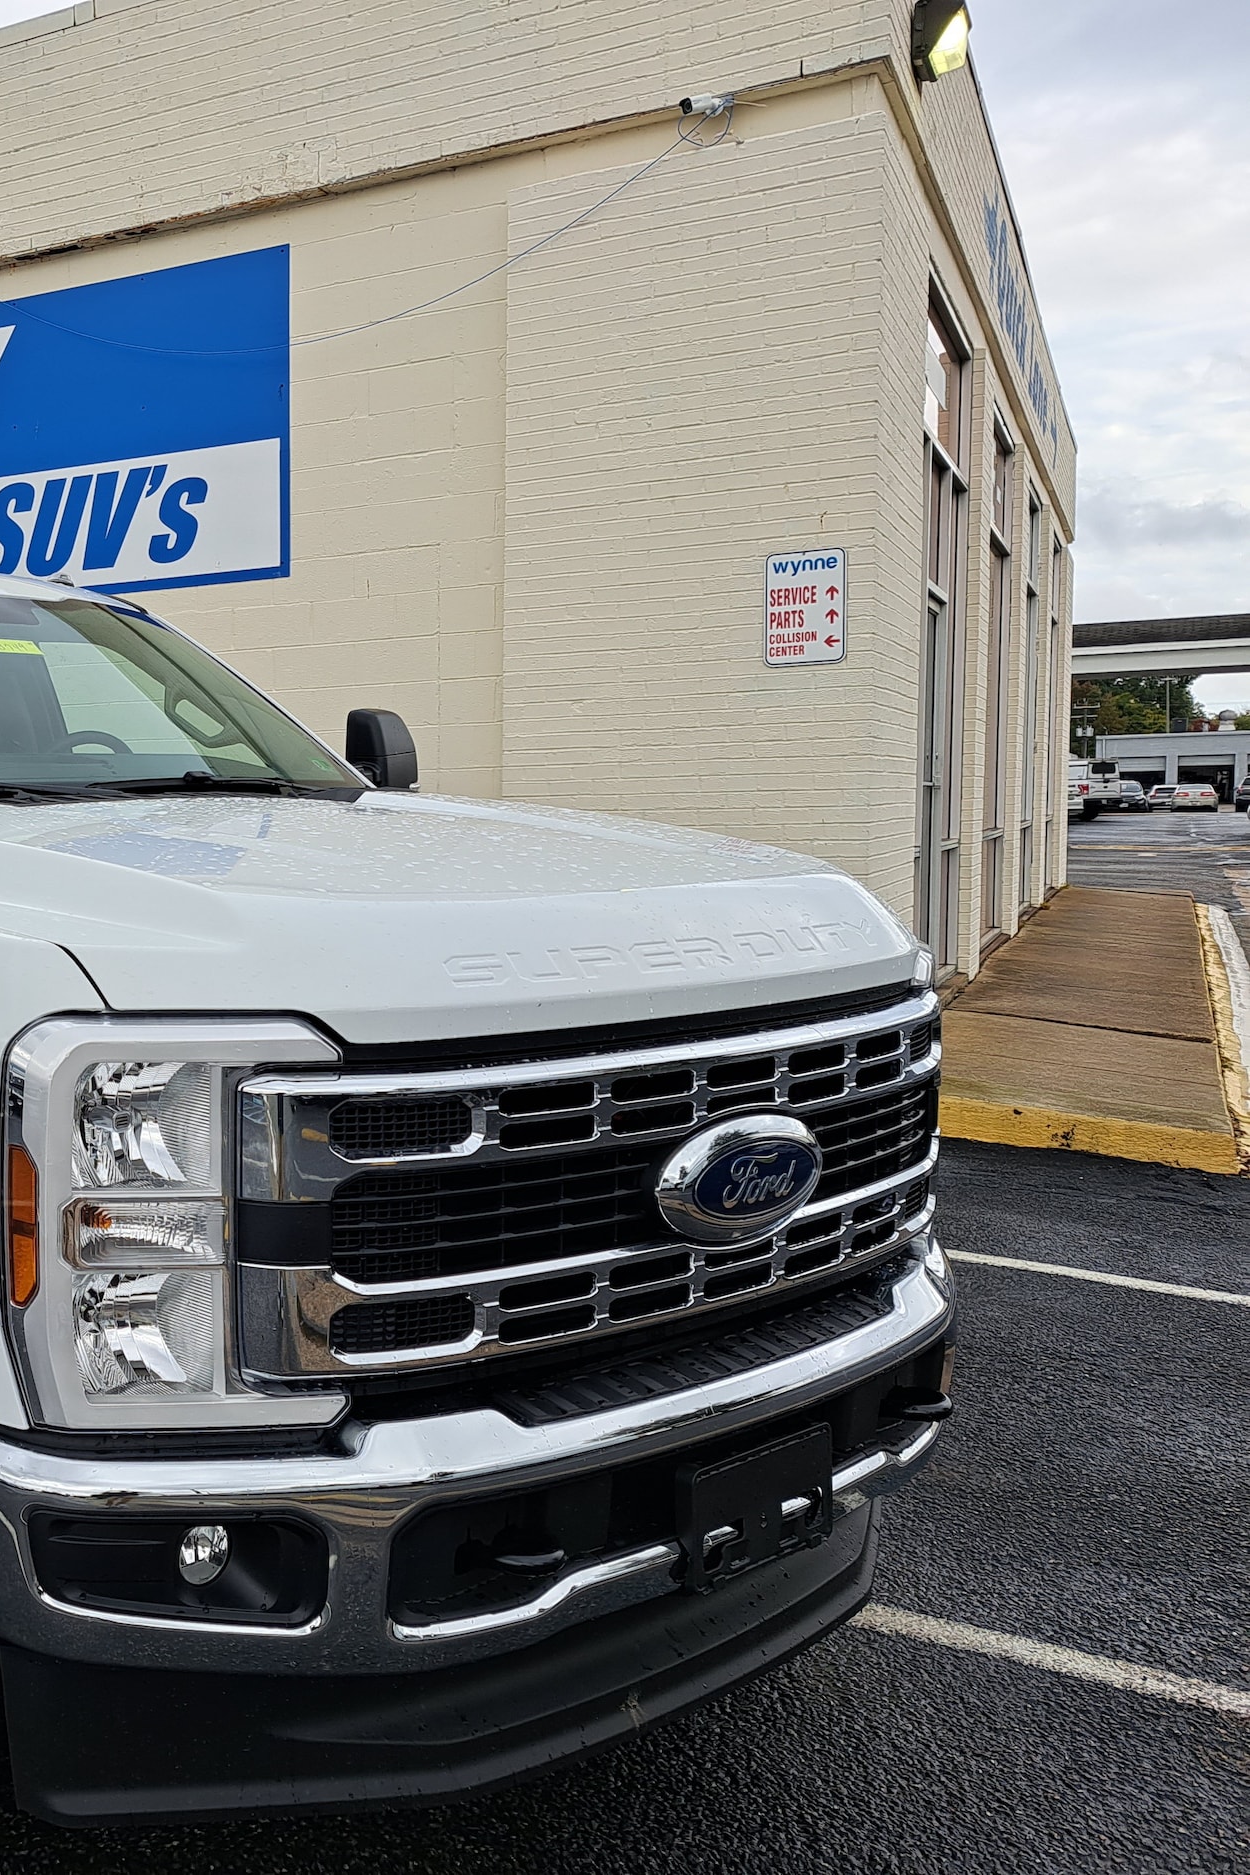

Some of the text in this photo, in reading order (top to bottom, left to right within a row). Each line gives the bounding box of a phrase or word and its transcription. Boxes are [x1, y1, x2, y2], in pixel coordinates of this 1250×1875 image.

[772, 556, 838, 577] wynne
[769, 585, 818, 608] SERVICE
[769, 609, 805, 630] PARTS
[769, 630, 818, 645] COLLISION
[769, 645, 805, 658] CENTER
[442, 917, 878, 989] SUPER DUTY
[722, 1152, 797, 1209] Ford
